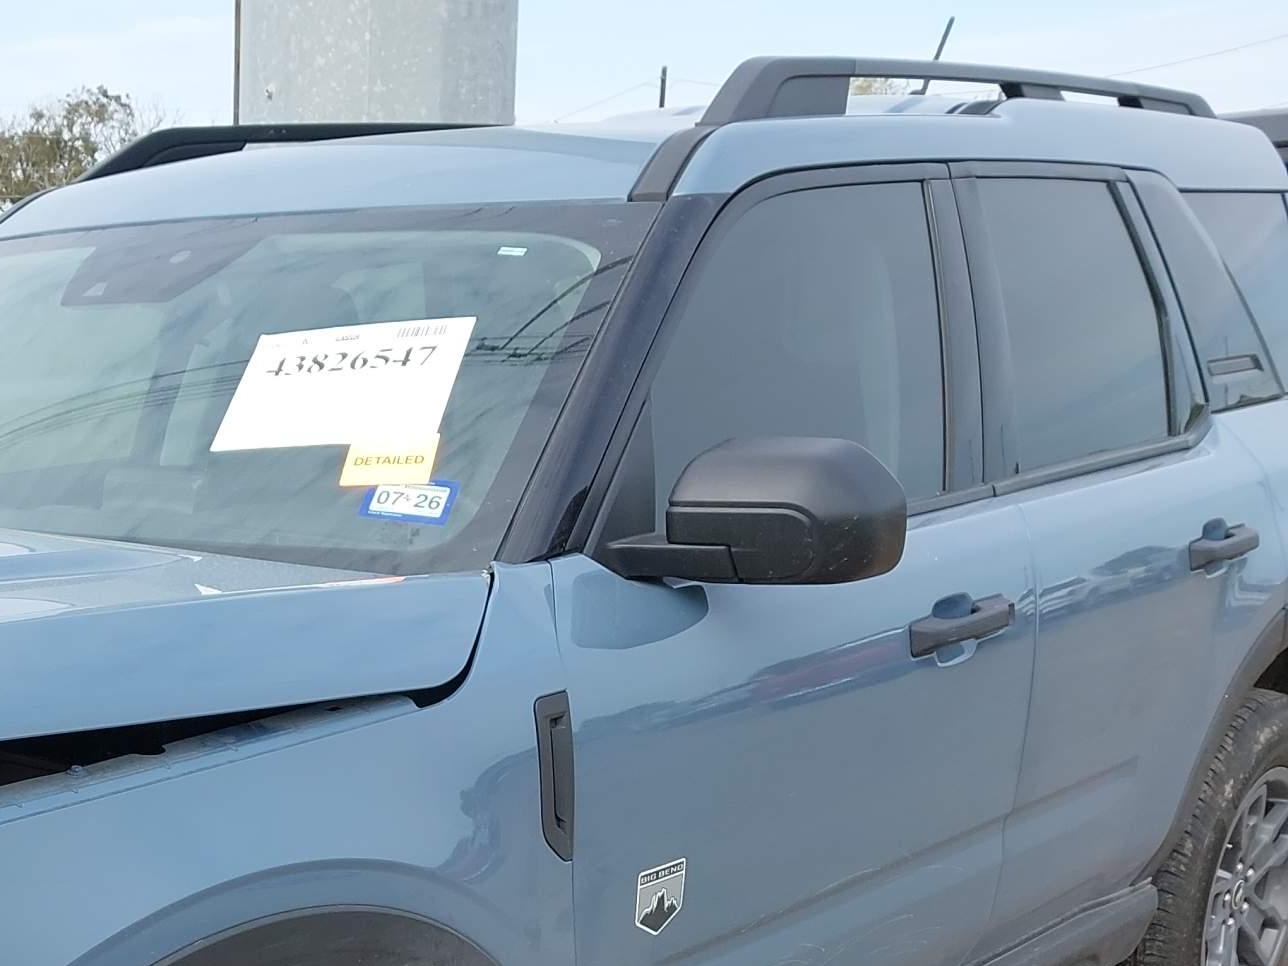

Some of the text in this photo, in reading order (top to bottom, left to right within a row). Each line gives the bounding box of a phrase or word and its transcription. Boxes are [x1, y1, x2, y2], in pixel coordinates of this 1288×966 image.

[266, 345, 438, 376] 43826547
[353, 454, 425, 467] DETAILED
[640, 863, 684, 884] BIG BEND
